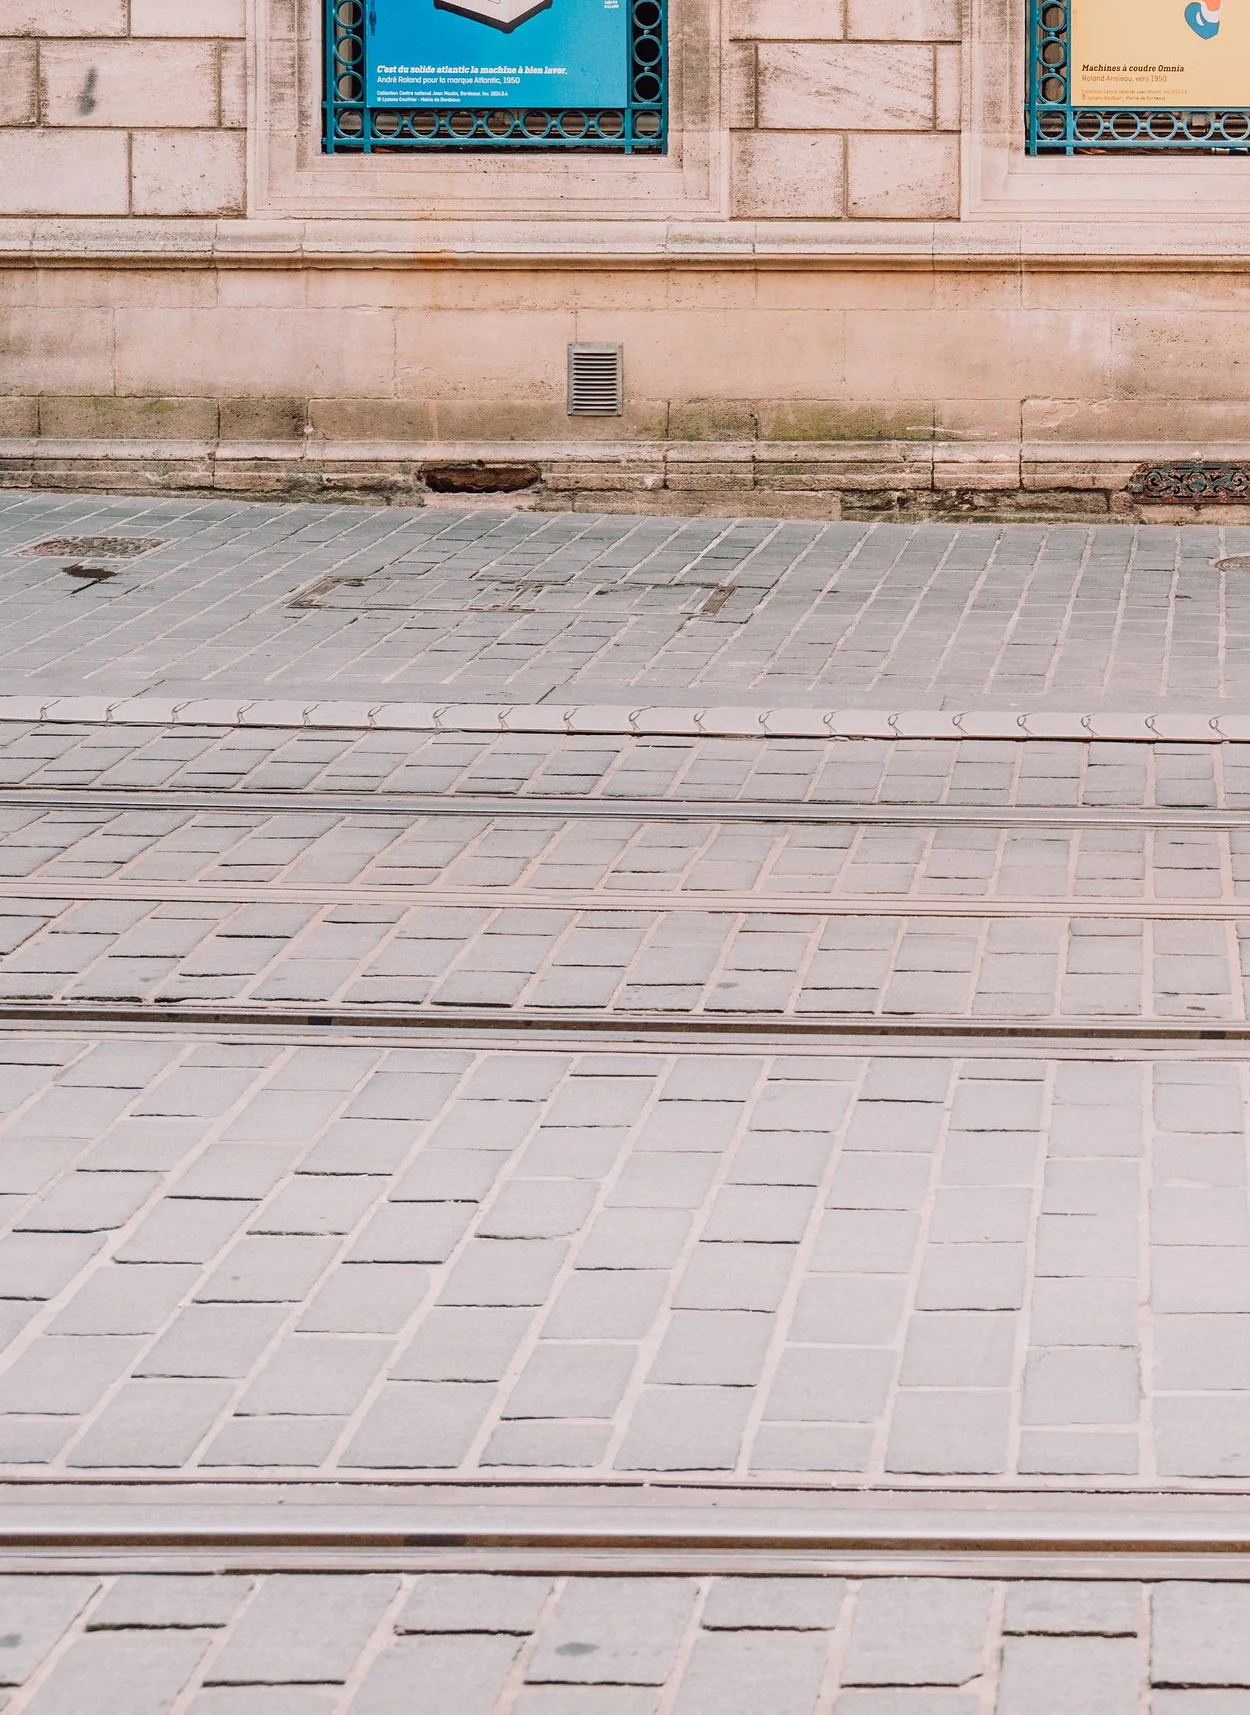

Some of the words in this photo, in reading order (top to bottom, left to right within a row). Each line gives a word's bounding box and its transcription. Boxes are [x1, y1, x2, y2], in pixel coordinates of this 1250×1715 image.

[377, 65, 396, 73] C'est
[398, 65, 409, 73] du
[410, 65, 435, 73] solide
[436, 65, 470, 73] atlantic
[470, 65, 479, 73] la
[480, 65, 517, 74] machine
[517, 65, 523, 74] à
[524, 65, 543, 74] bien
[1082, 64, 1121, 72] Machines
[1122, 64, 1127, 72] à
